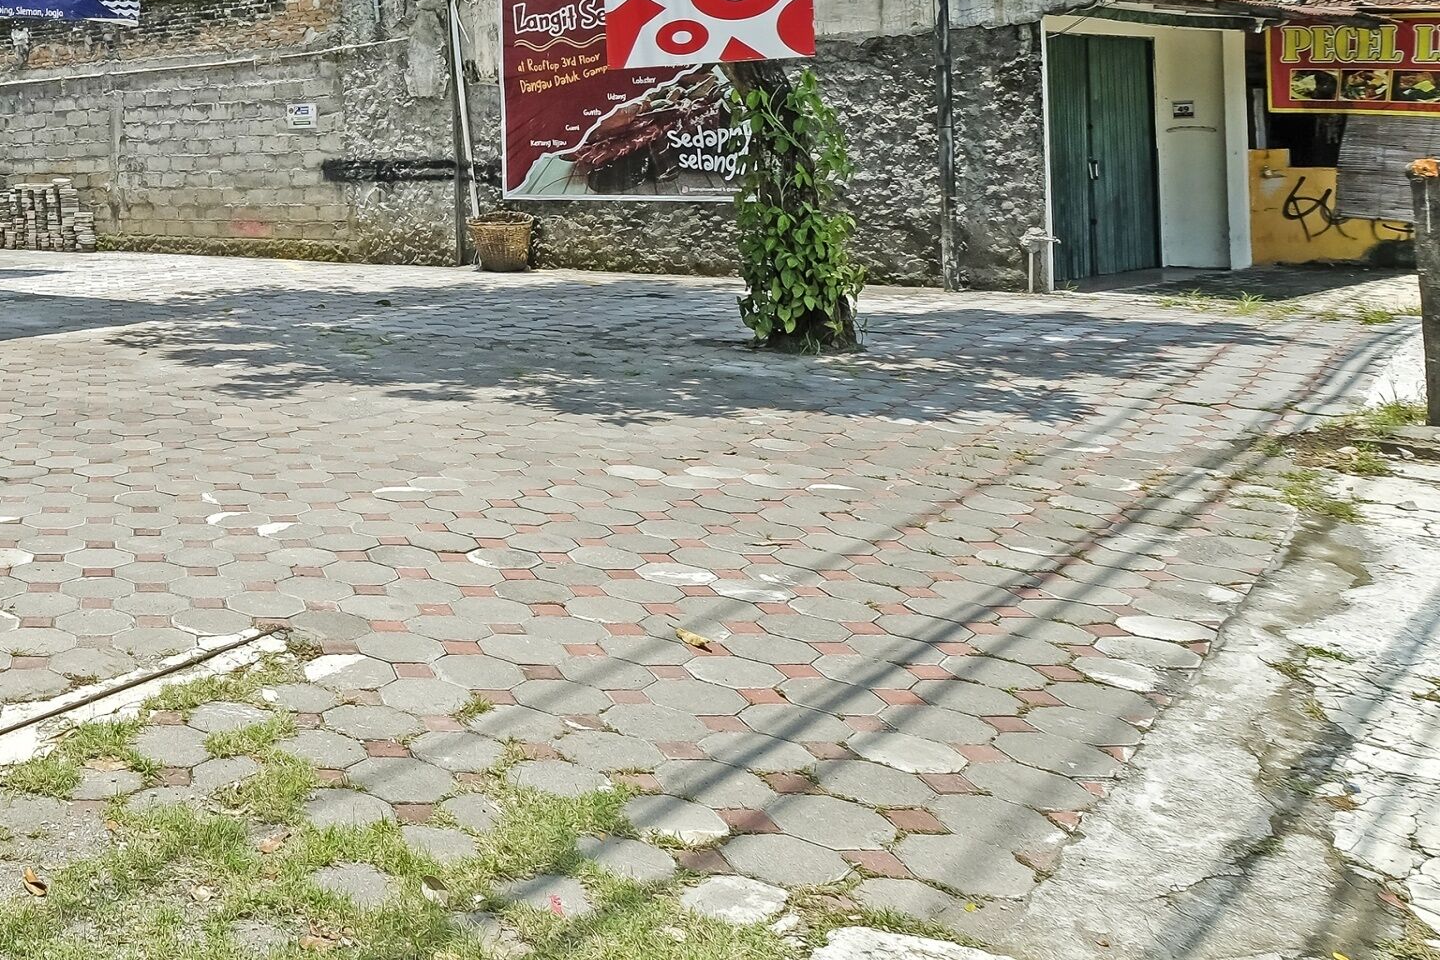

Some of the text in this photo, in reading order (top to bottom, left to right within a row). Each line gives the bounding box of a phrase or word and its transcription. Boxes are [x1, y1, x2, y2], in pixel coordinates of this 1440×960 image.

[45, 7, 64, 19] Jogja
[512, 2, 577, 37] Langit
[1280, 24, 1440, 64] PECEL L
[527, 58, 560, 74] Rooftop
[560, 55, 577, 68] 3rd
[578, 52, 601, 65] Floor
[519, 65, 610, 94] Dangau Datuk Gamp
[678, 148, 747, 181] selang
